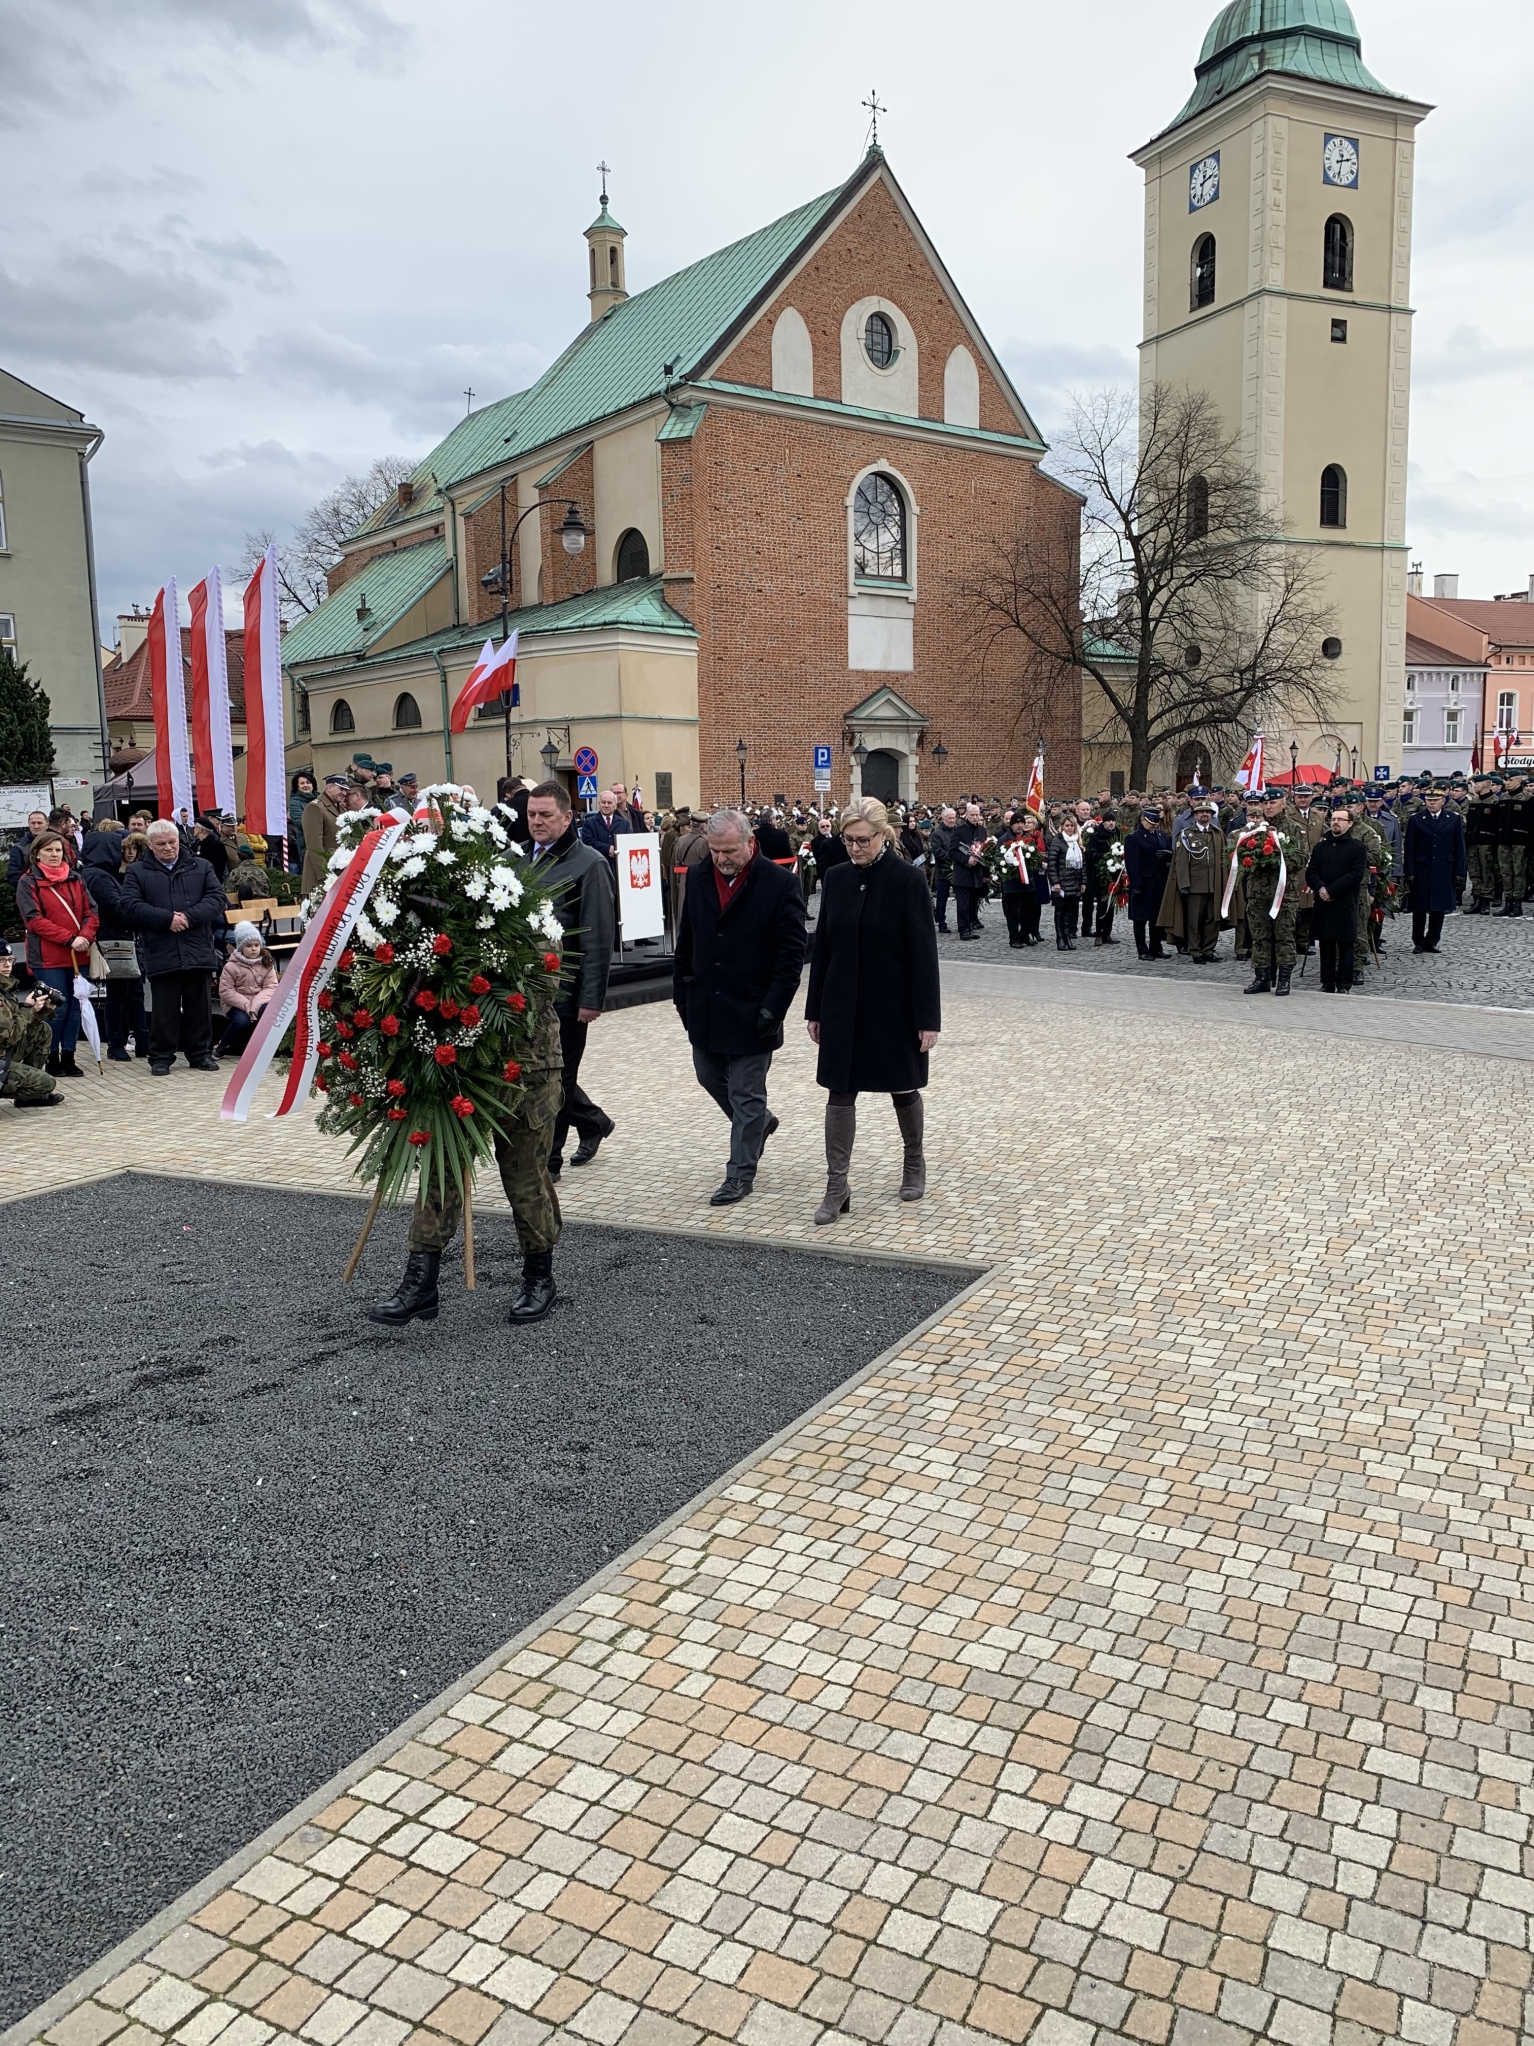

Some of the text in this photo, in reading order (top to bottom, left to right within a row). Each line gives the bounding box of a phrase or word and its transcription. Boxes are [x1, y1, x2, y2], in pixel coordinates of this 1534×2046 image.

[818, 748, 828, 766] P
[342, 869, 372, 906] RADA
[315, 910, 352, 961] POWIATU
[298, 965, 328, 1061] RZESZOWSKIEGO
